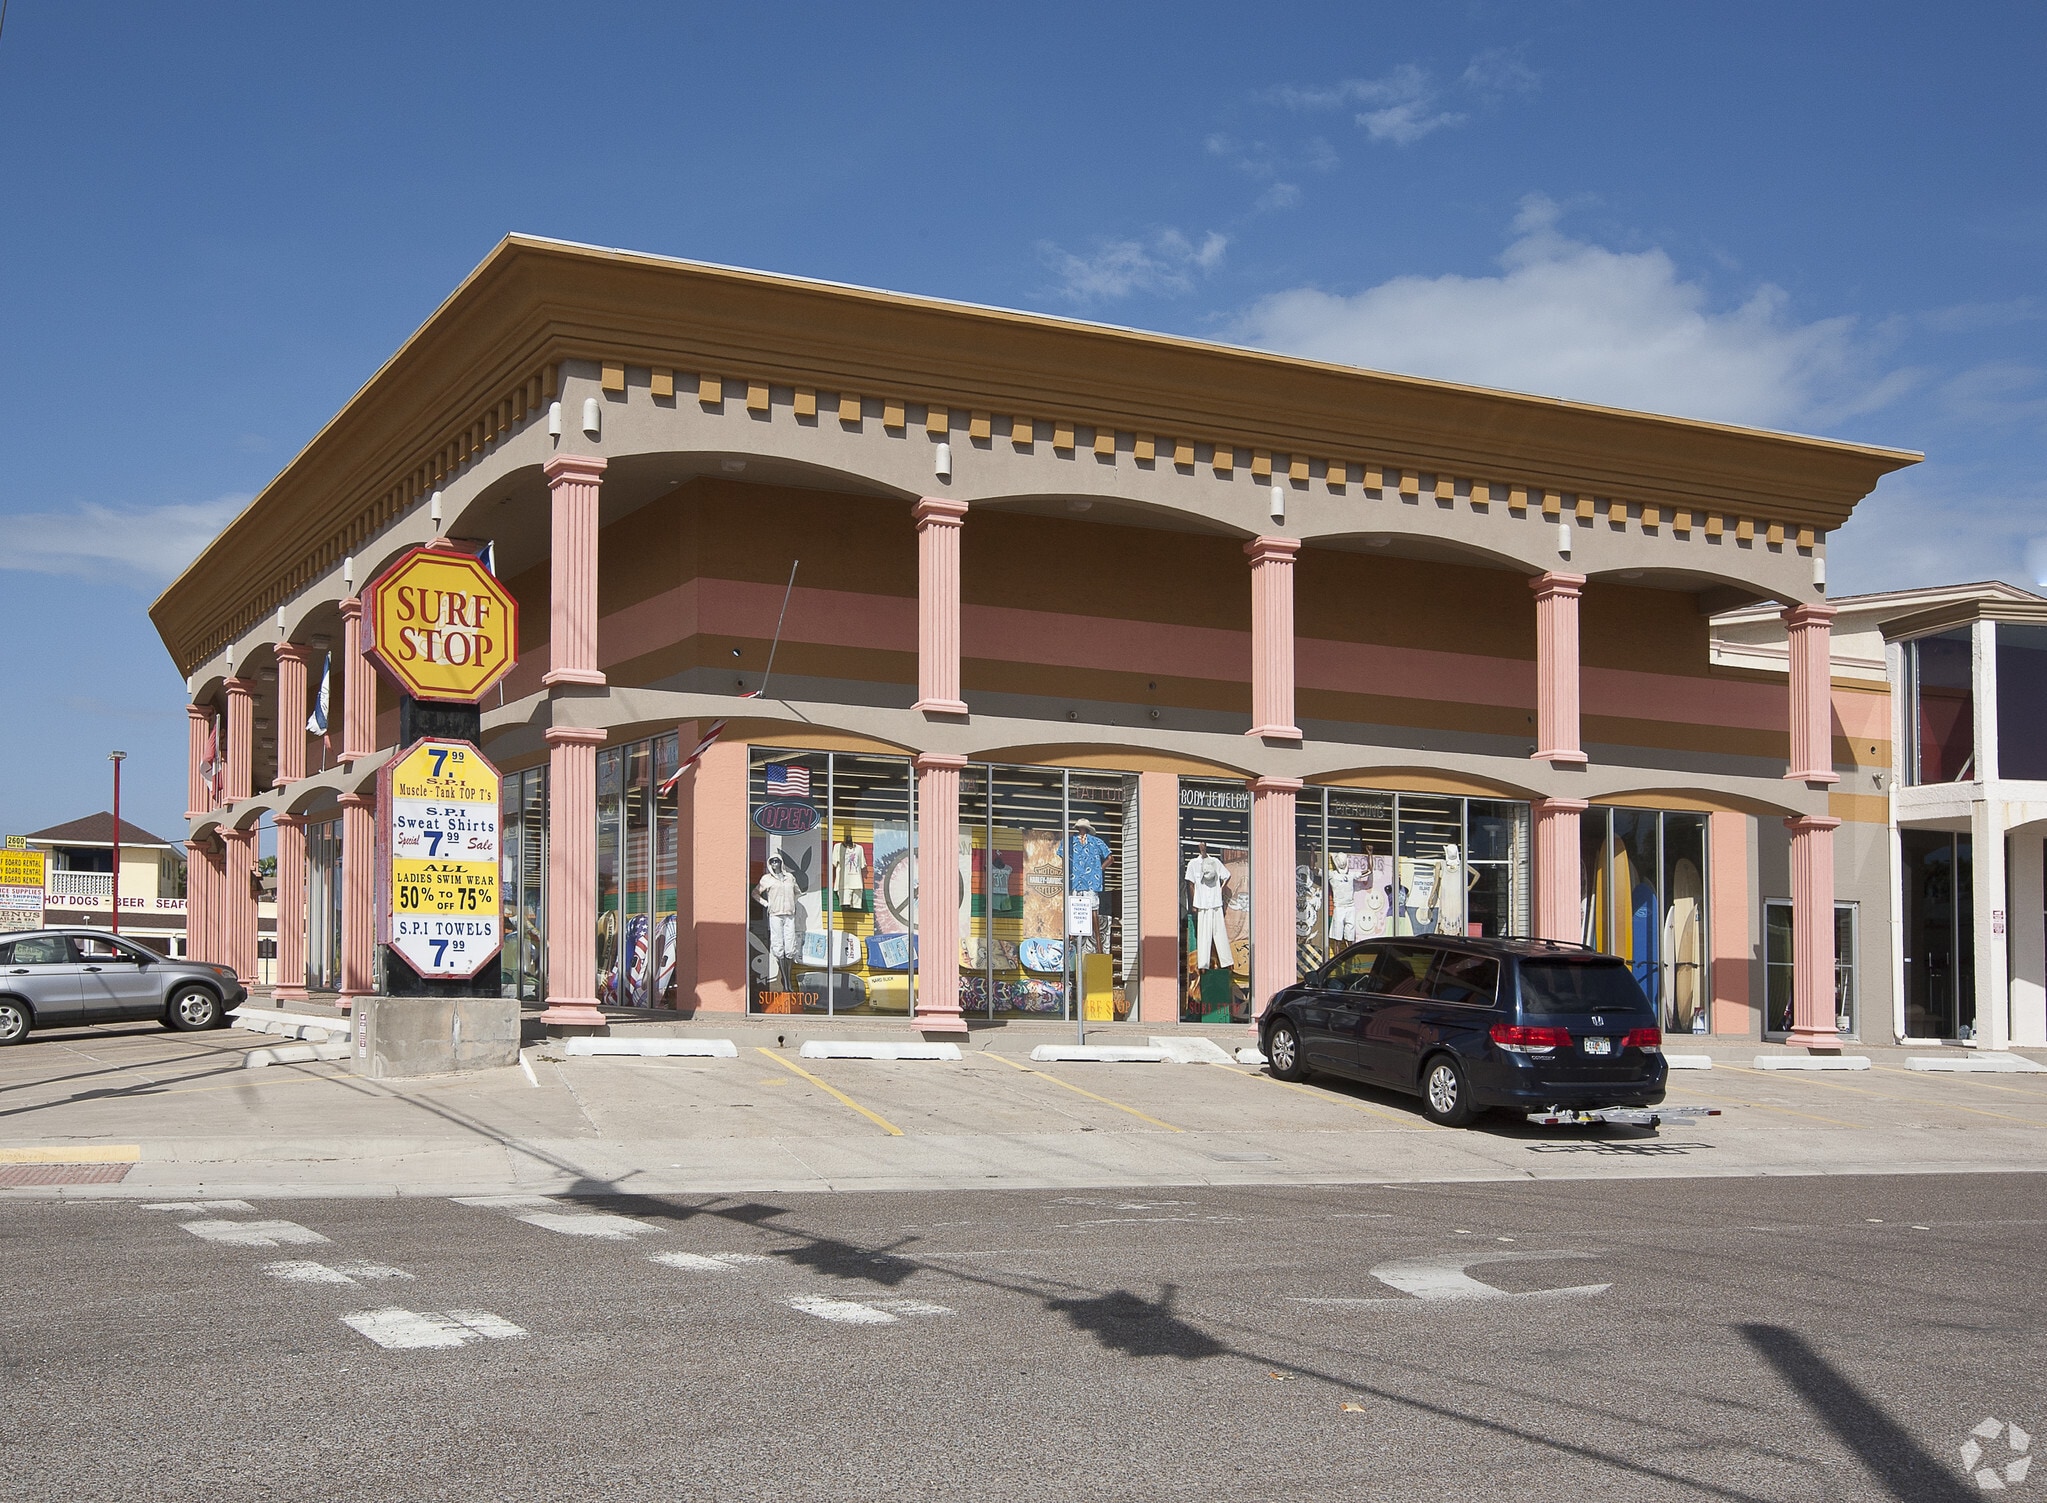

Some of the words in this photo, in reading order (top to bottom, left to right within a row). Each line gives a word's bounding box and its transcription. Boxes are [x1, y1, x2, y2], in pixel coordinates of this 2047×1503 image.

[397, 586, 492, 629] SURF
[398, 626, 493, 668] STOP
[426, 778, 466, 787] S.P.I
[399, 783, 428, 797] Muscle
[435, 786, 455, 799] Tank
[460, 787, 476, 800] TOP
[480, 789, 492, 801] T's
[1181, 789, 1205, 806] BODY
[1207, 790, 1248, 809] JEWELRY
[426, 807, 466, 817] S.P.I
[761, 806, 812, 831] OPEN
[397, 815, 440, 829] Sweat
[448, 818, 494, 832] Shirts
[8, 836, 25, 845] 2600
[467, 837, 493, 850] Sale
[423, 864, 468, 873] ALL
[397, 873, 432, 884] LADIES
[437, 874, 462, 885] SWIM
[466, 875, 494, 886] WEAR
[45, 895, 66, 905] HOT
[69, 896, 99, 906] DOGS
[400, 885, 434, 909] 50%
[439, 891, 453, 899] TO
[458, 887, 492, 910] 75%
[437, 902, 455, 910] OFF
[400, 921, 428, 935] S.P.I
[436, 922, 492, 936] TOWELS
[791, 991, 819, 1006] STOP
